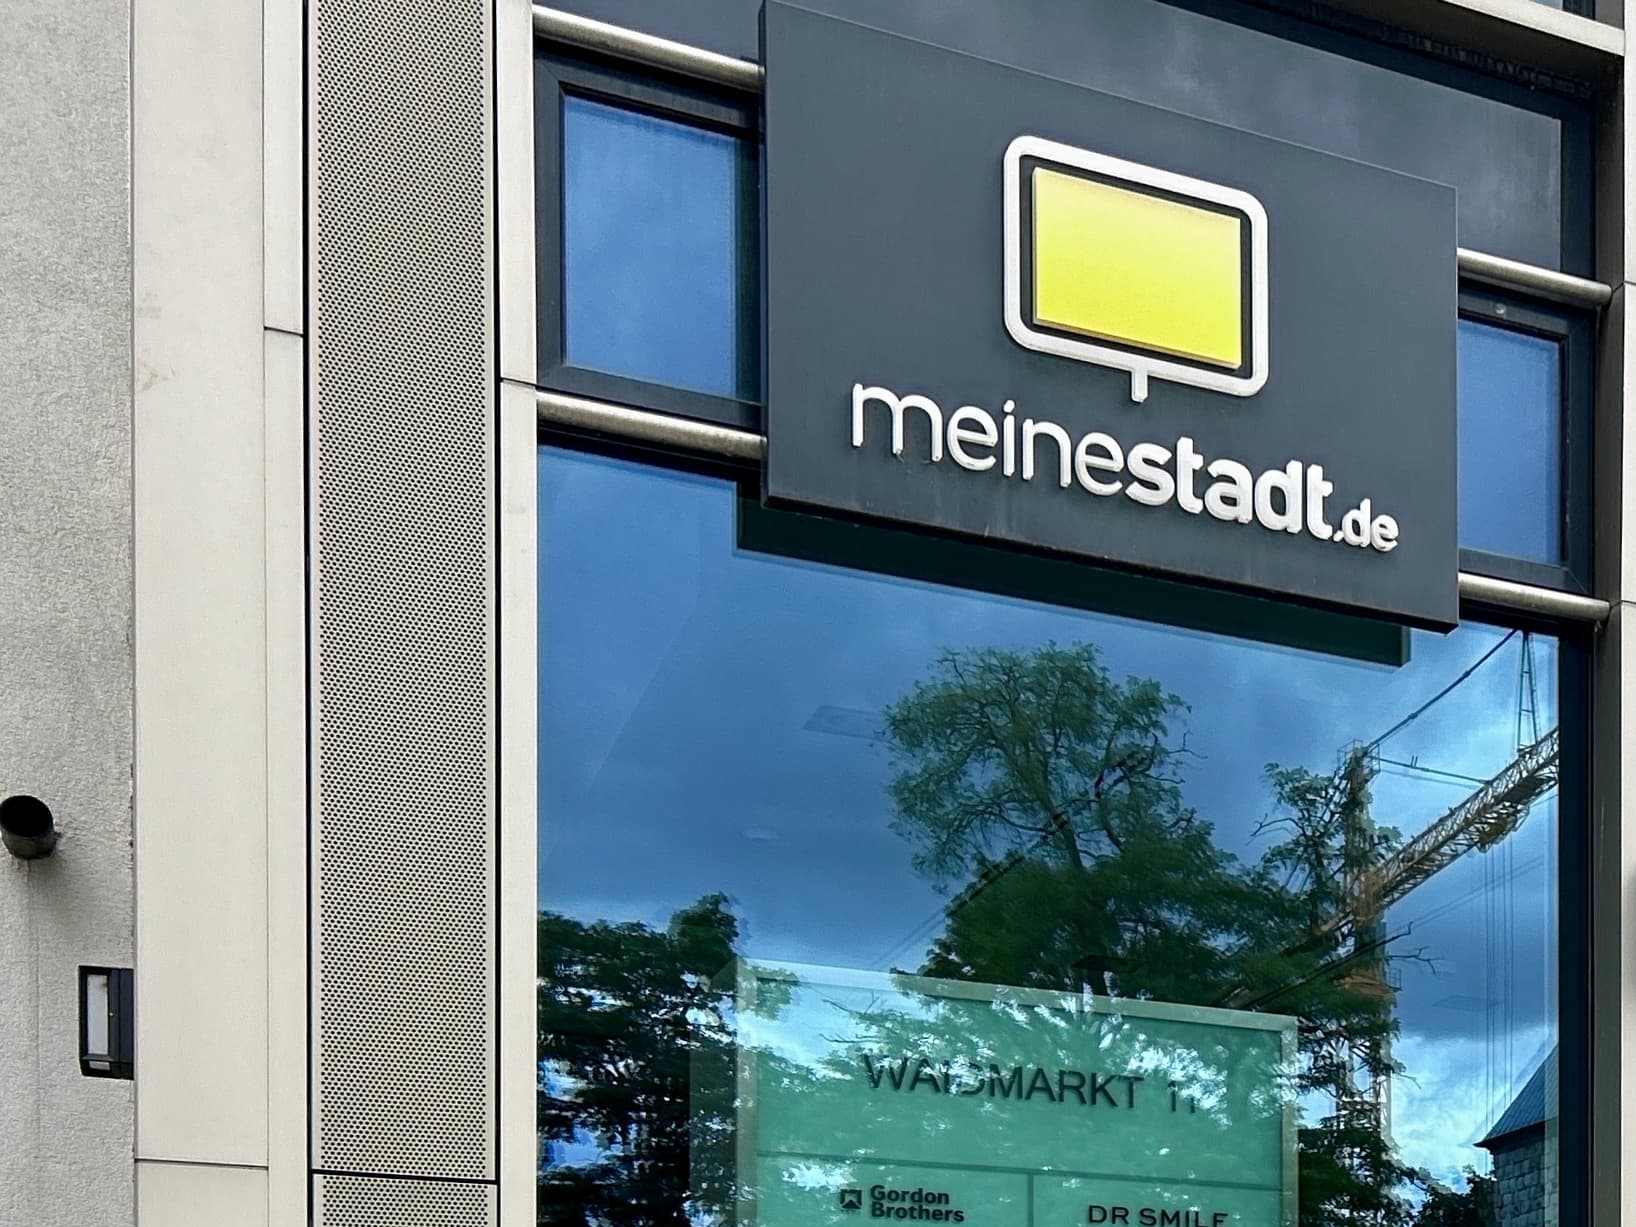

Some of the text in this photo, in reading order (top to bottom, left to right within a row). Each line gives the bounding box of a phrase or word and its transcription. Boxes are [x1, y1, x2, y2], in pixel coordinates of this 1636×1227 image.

[851, 382, 1399, 552] meinestadt.de
[870, 1184, 950, 1205] Gordon
[870, 1201, 966, 1222] Brothers
[1088, 1204, 1130, 1225] DR
